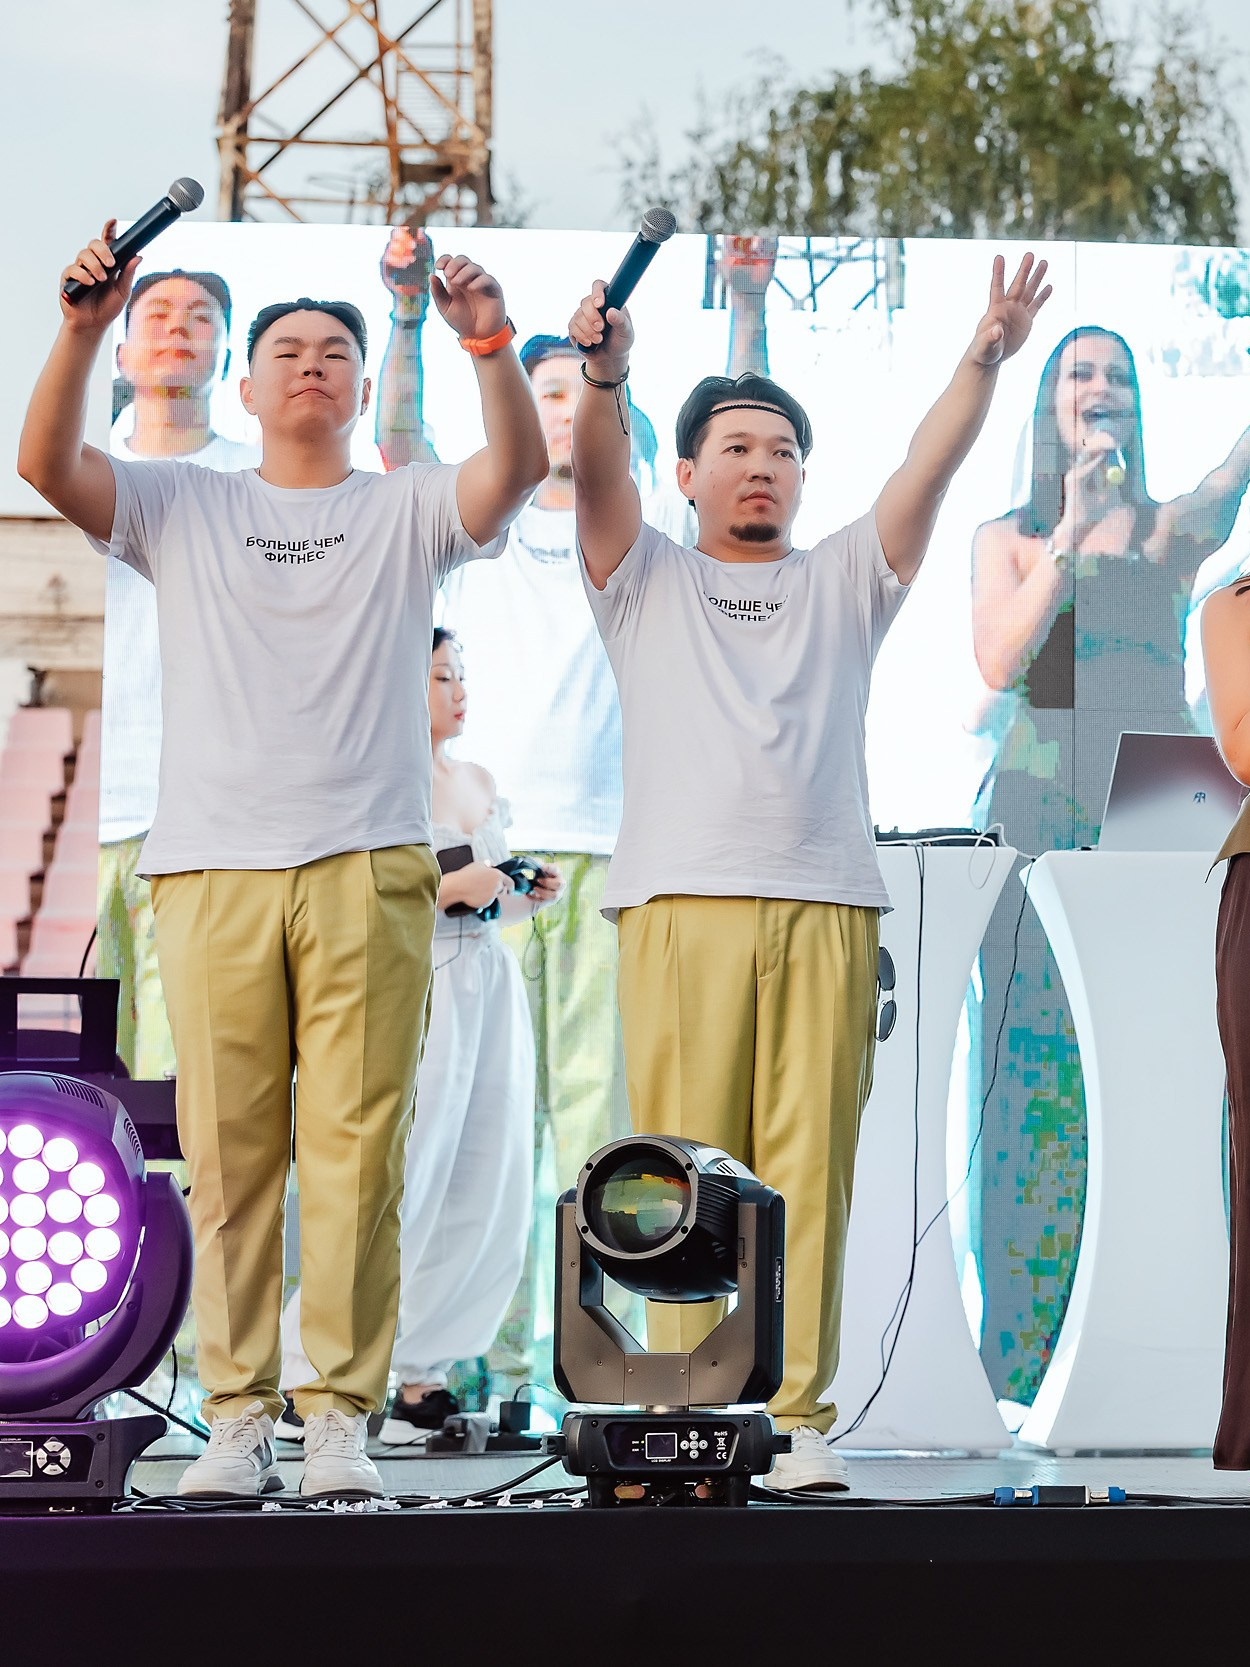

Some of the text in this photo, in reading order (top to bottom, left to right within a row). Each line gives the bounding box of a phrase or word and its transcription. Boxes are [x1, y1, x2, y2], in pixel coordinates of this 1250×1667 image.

[246, 533, 345, 551] БОЛЬШЕ ЧЕМ
[264, 550, 326, 564] ФИТНЕС
[704, 594, 788, 612] ОЛЬШЕ ЧЕ
